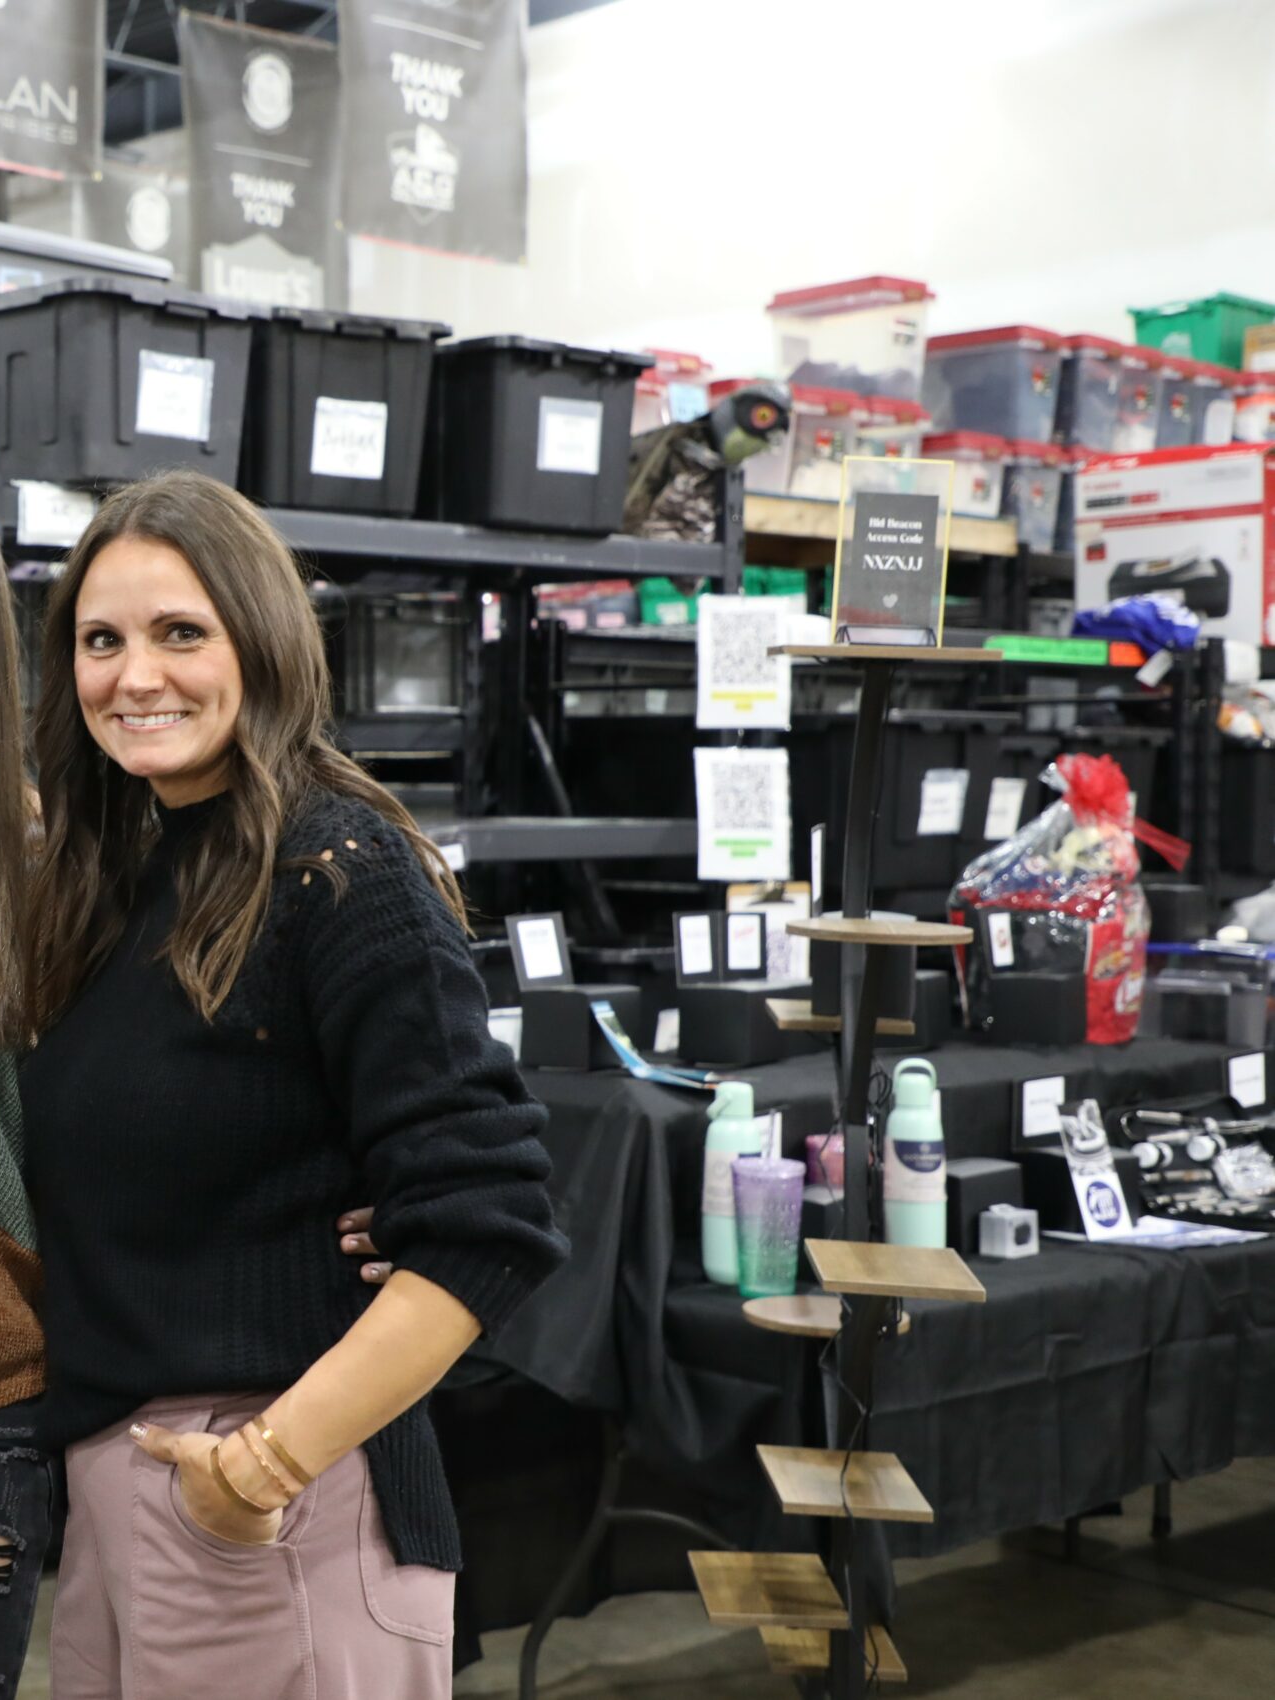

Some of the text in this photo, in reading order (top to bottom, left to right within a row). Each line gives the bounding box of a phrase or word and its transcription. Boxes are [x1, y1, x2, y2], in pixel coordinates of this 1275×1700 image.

[391, 51, 465, 98] THANK
[399, 84, 449, 121] YOU
[230, 172, 296, 207] THANK
[241, 199, 286, 228] YOU
[867, 532, 923, 544] Access Code
